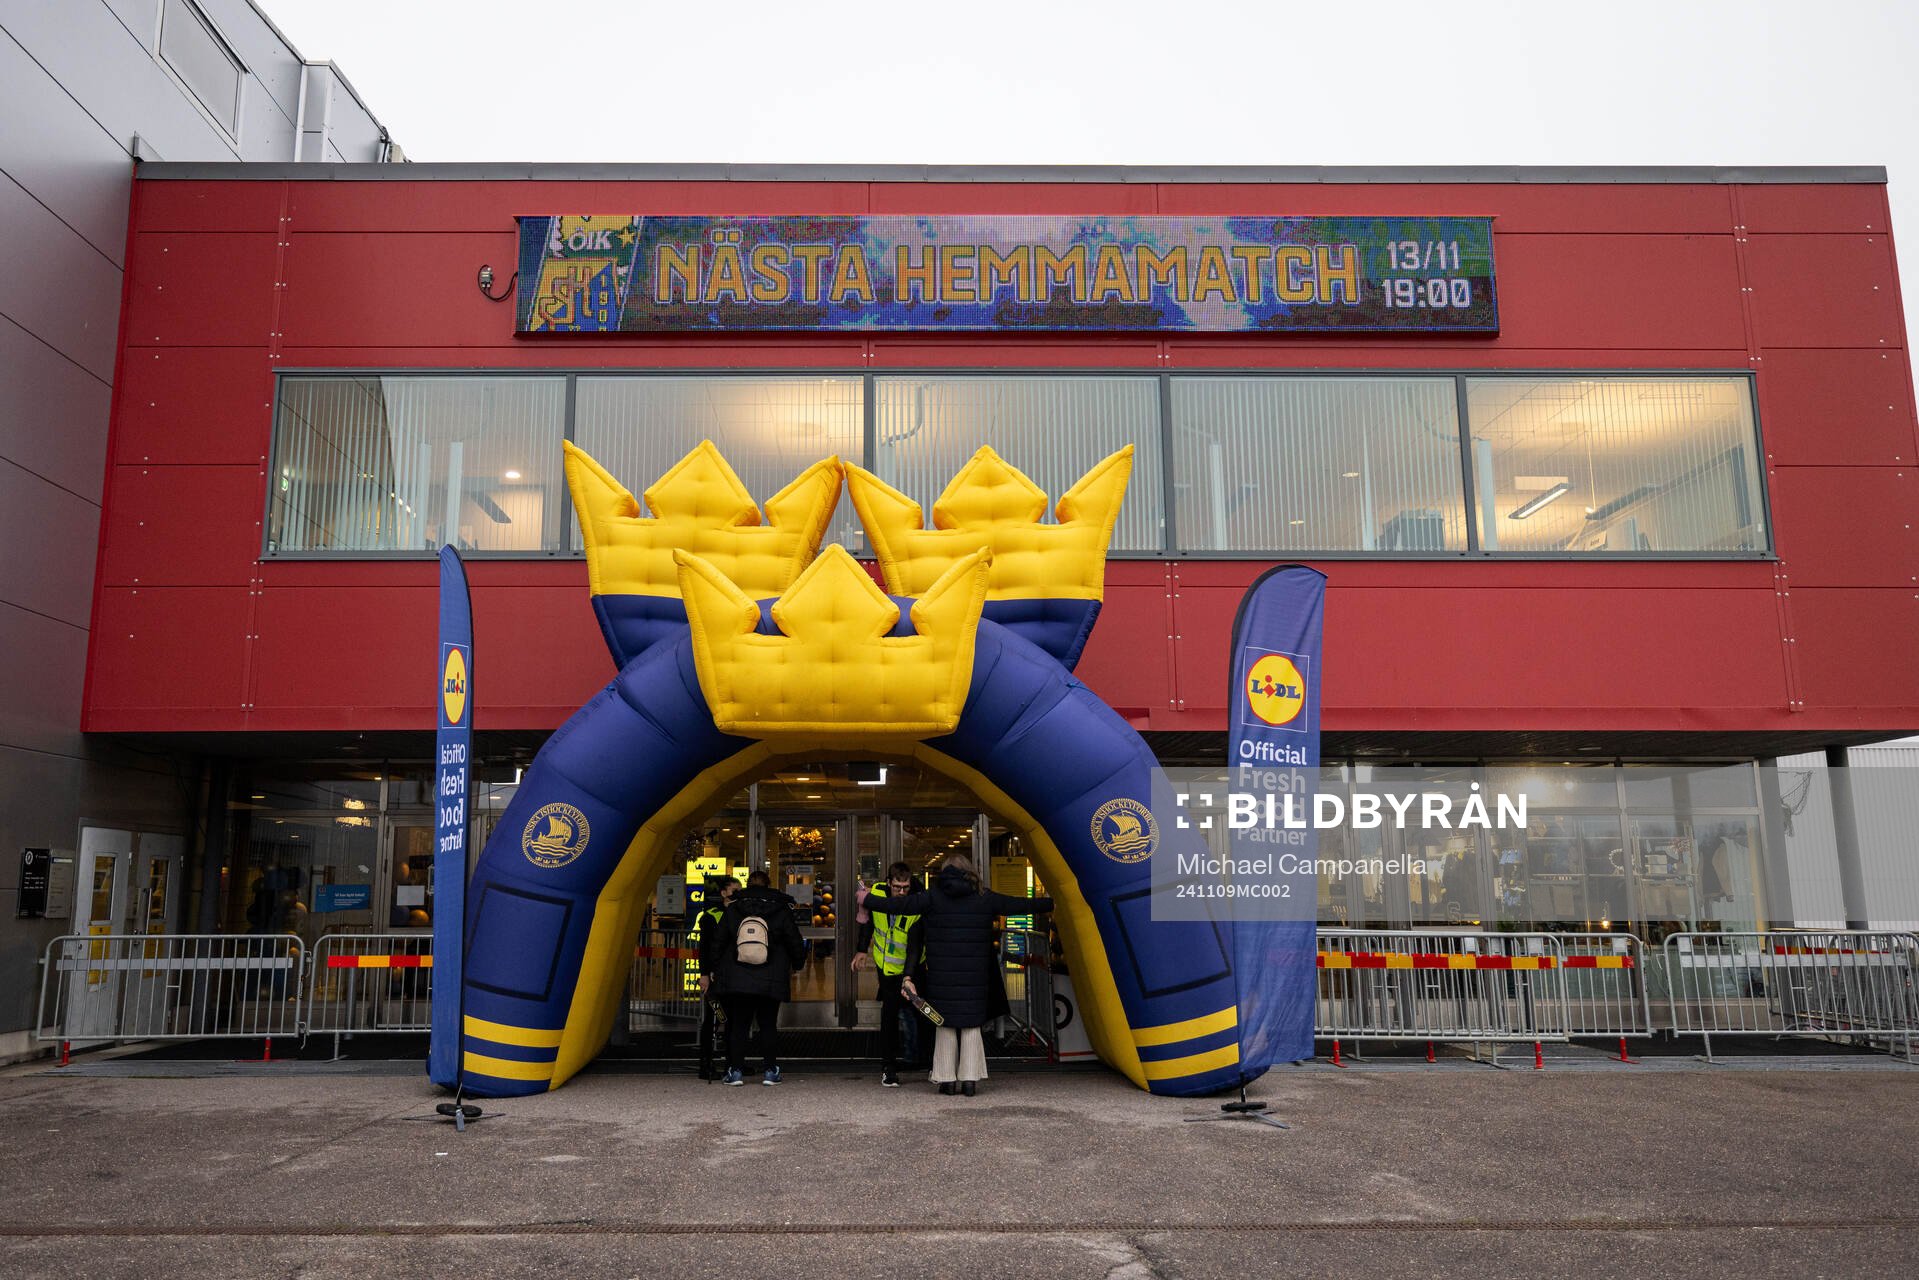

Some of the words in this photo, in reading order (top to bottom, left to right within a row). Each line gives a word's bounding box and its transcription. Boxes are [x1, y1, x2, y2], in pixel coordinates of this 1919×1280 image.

[654, 229, 877, 304] NÄSTA
[894, 243, 1361, 304] HEMMAMATCH
[1386, 240, 1459, 269] 13/11
[1381, 279, 1470, 308] 19:00
[1239, 739, 1307, 766] Official
[1239, 762, 1306, 794] Fresh
